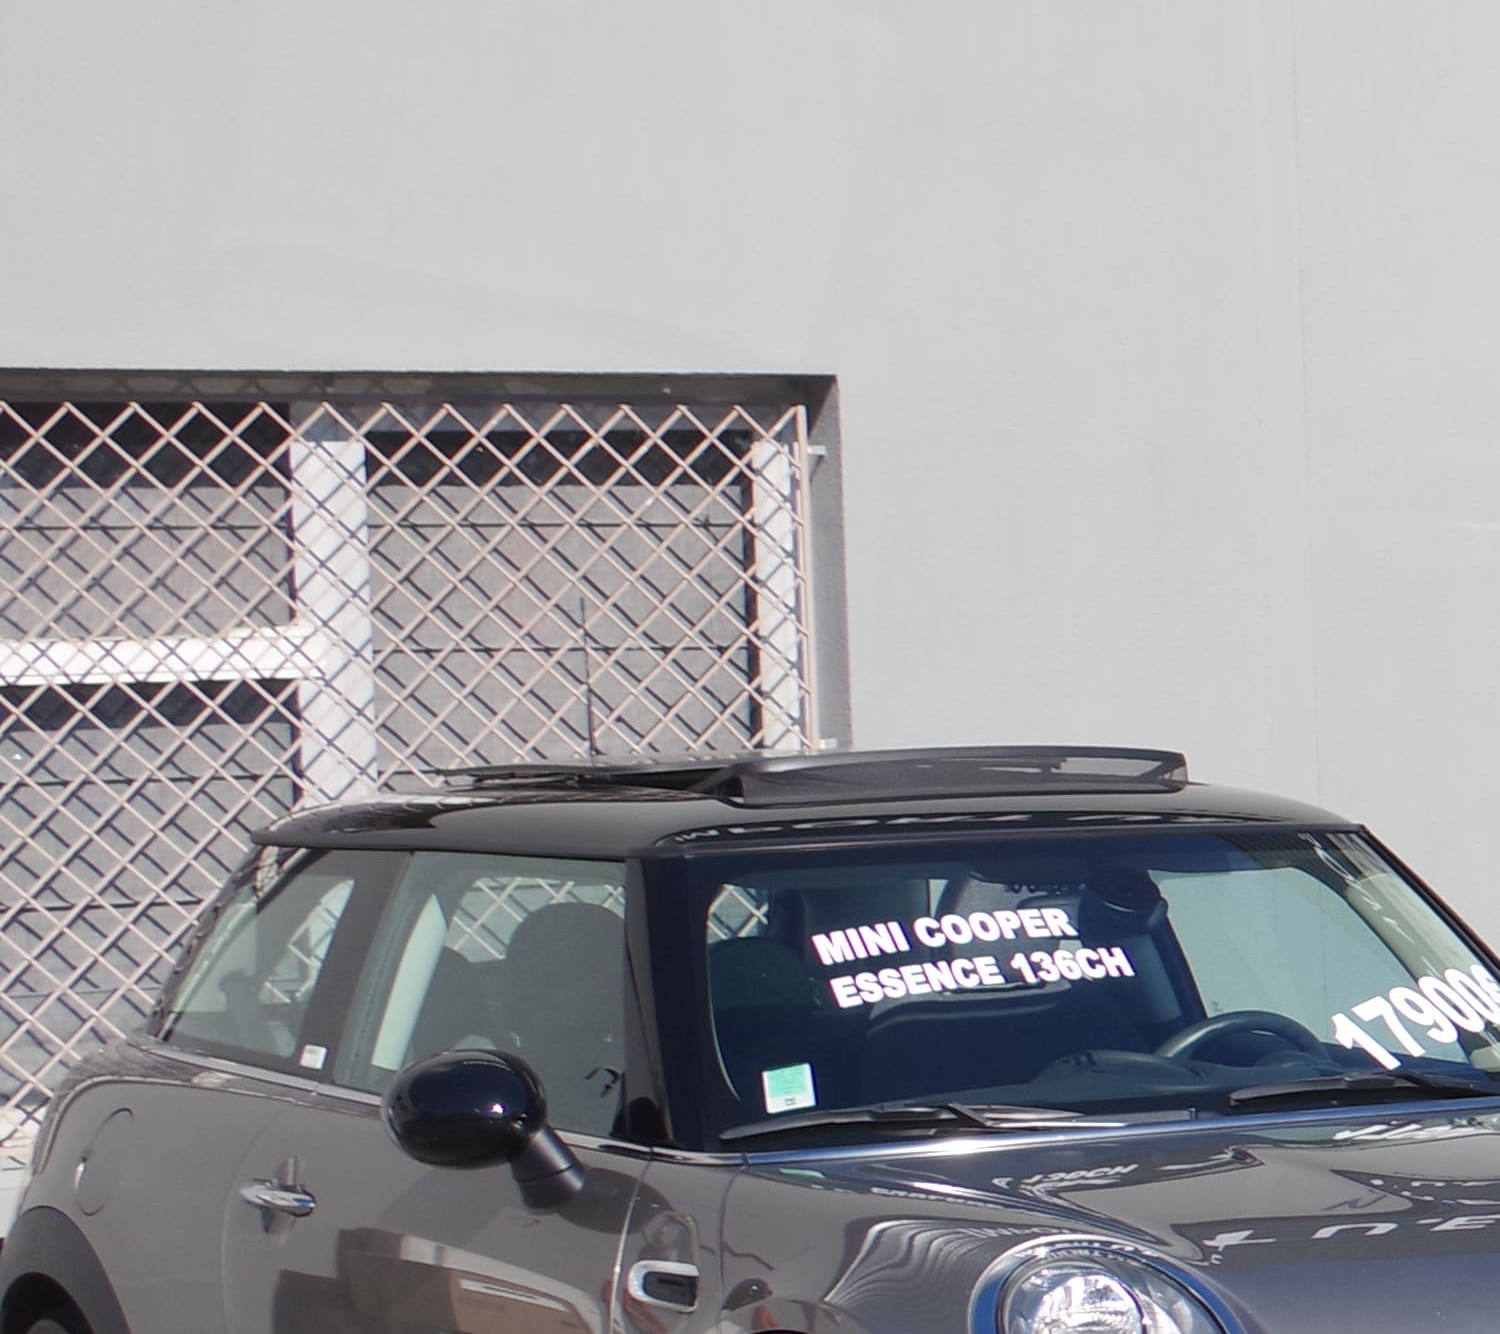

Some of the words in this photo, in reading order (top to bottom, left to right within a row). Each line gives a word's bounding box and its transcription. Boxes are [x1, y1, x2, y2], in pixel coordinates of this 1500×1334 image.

[811, 919, 909, 966] MINI
[912, 906, 1079, 946] COOPER
[828, 956, 1005, 1009] ESSENCE
